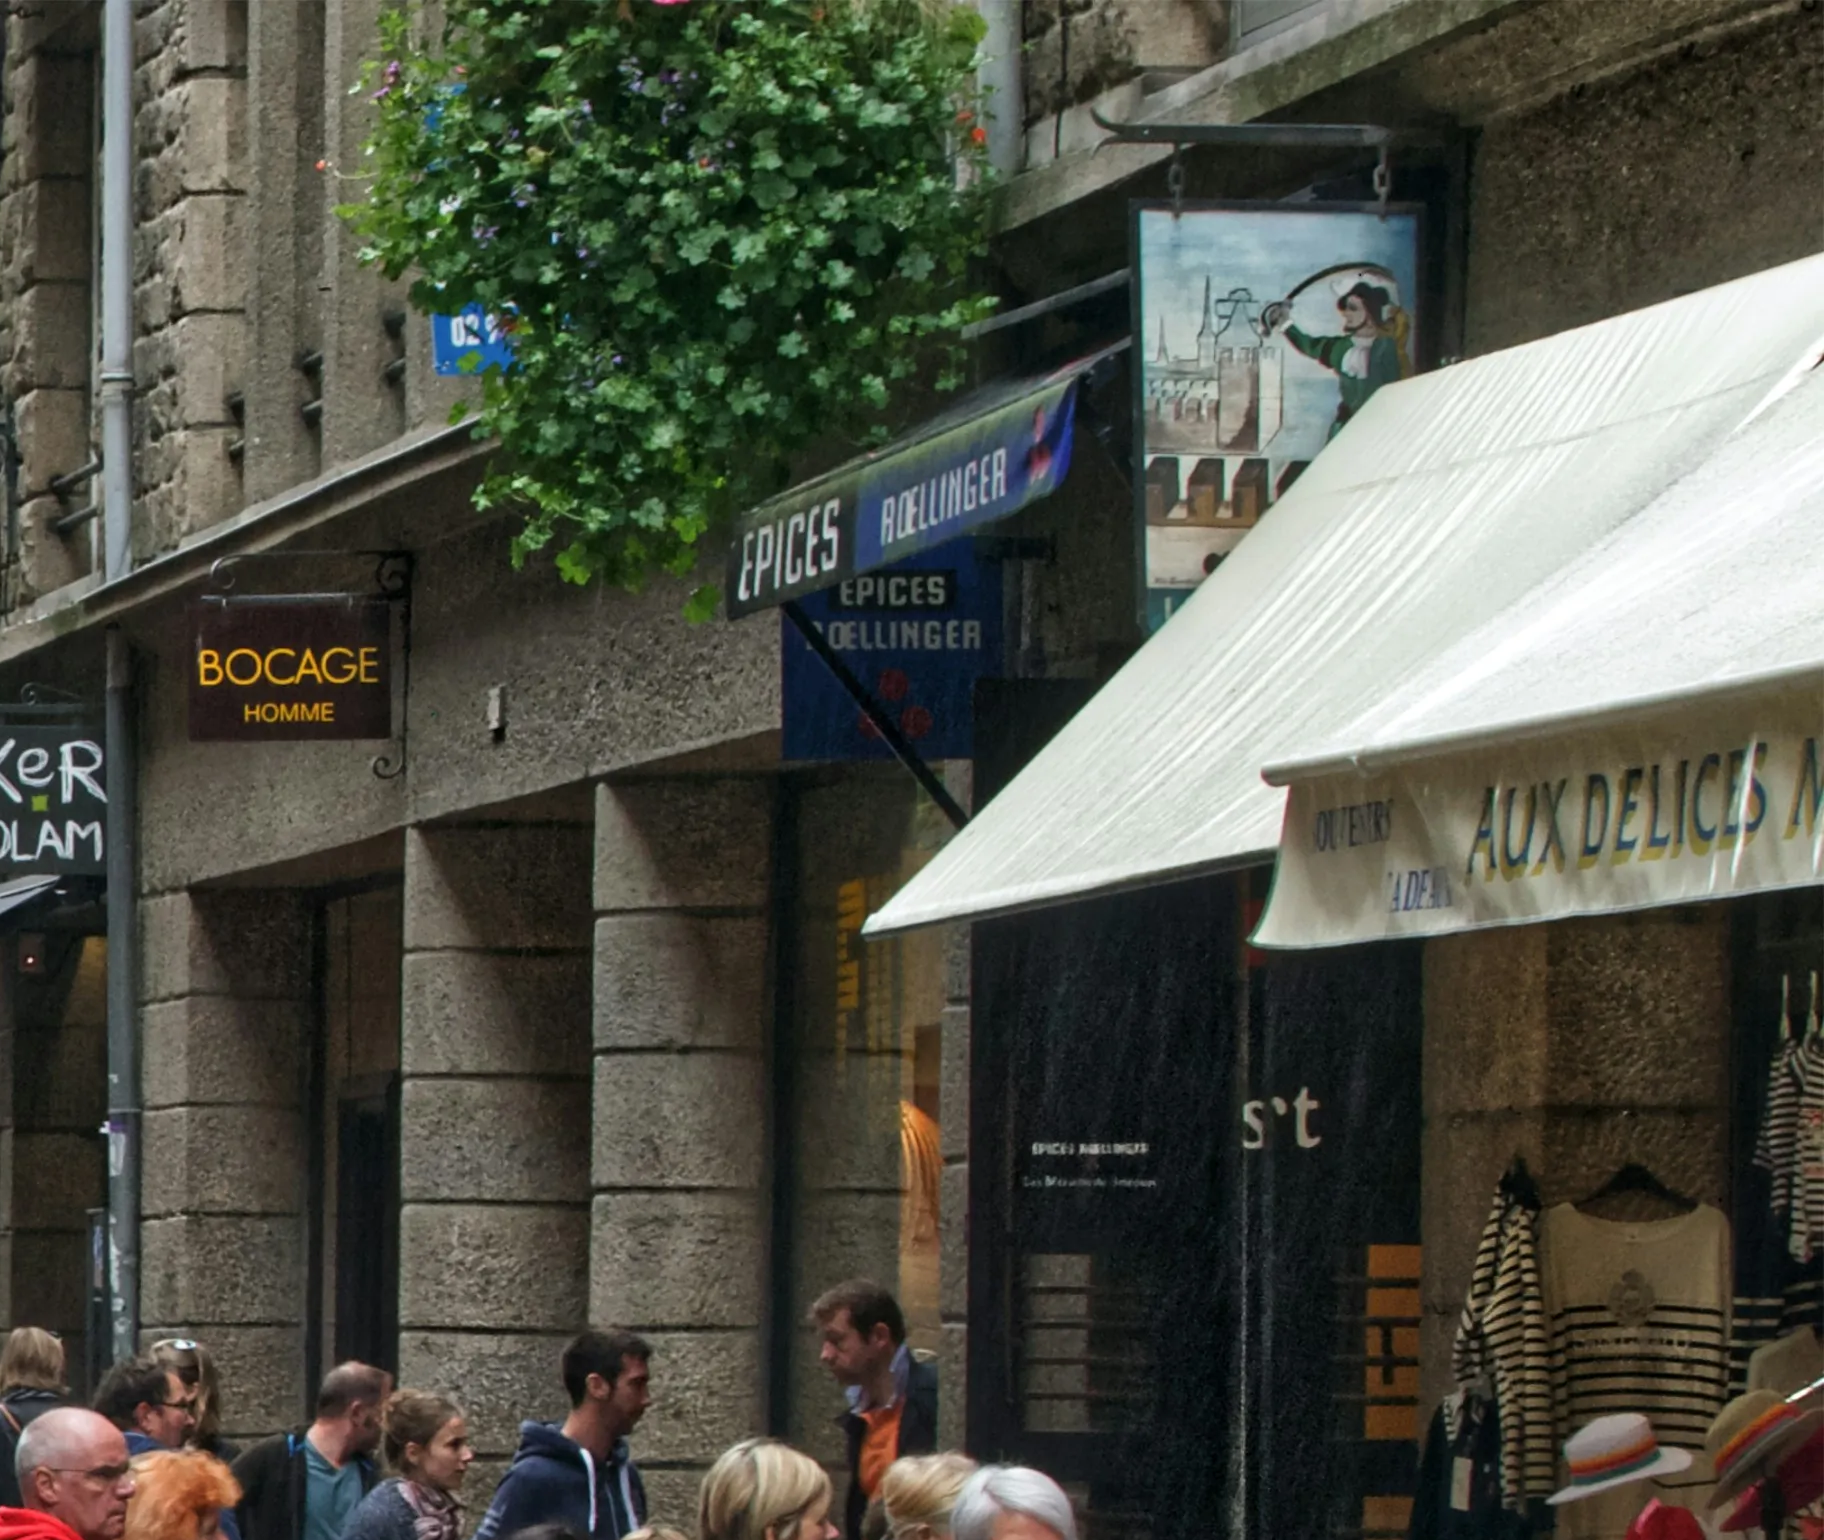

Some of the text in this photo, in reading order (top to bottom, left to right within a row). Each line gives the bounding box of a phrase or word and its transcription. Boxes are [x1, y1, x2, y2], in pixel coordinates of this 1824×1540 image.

[737, 498, 841, 602] EPICES
[839, 576, 947, 607] EPICES
[198, 646, 379, 686] BOCAGE
[243, 702, 336, 723] HOMME
[1462, 776, 1570, 885] AUX
[1579, 740, 1769, 872] DELICES
